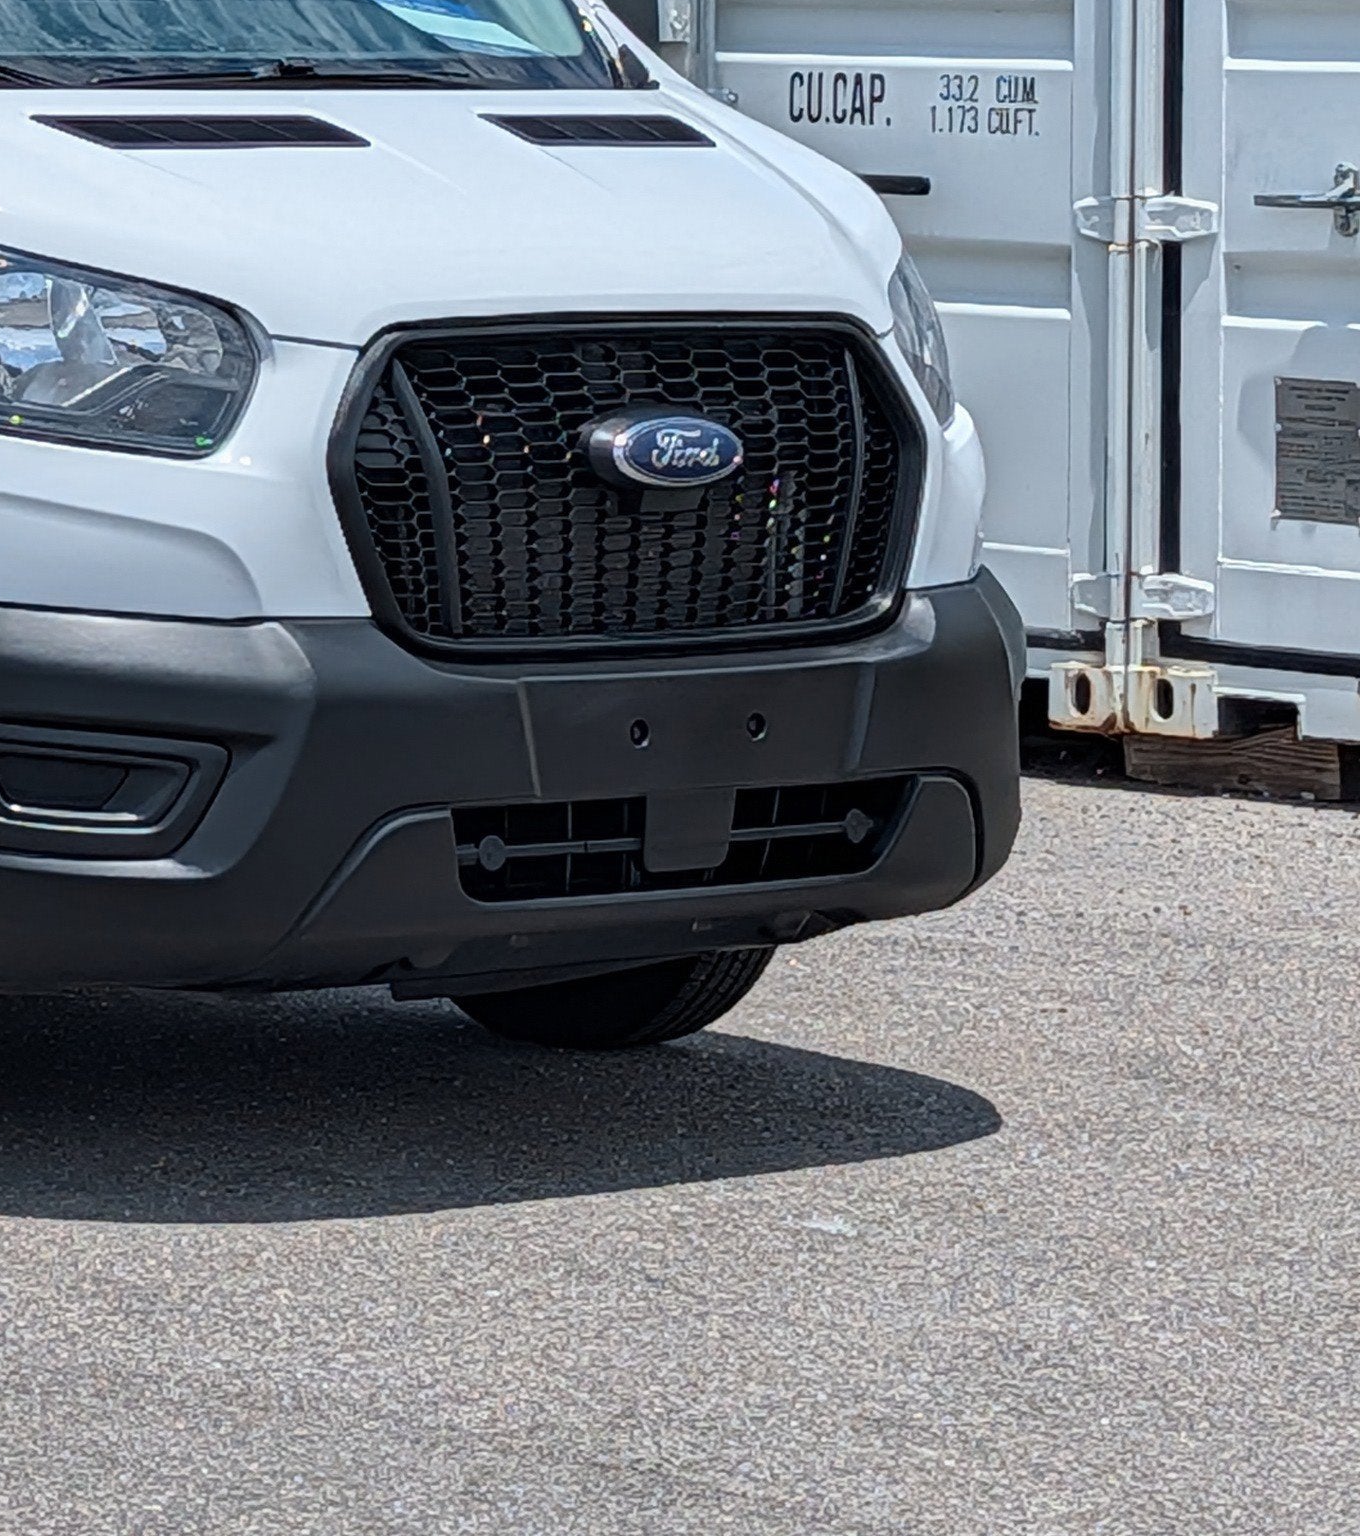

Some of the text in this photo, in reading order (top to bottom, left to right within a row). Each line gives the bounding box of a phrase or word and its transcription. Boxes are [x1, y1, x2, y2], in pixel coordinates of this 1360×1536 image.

[789, 71, 891, 127] CU.CAP.
[930, 104, 979, 135] 1.173
[651, 428, 720, 470] Ford
